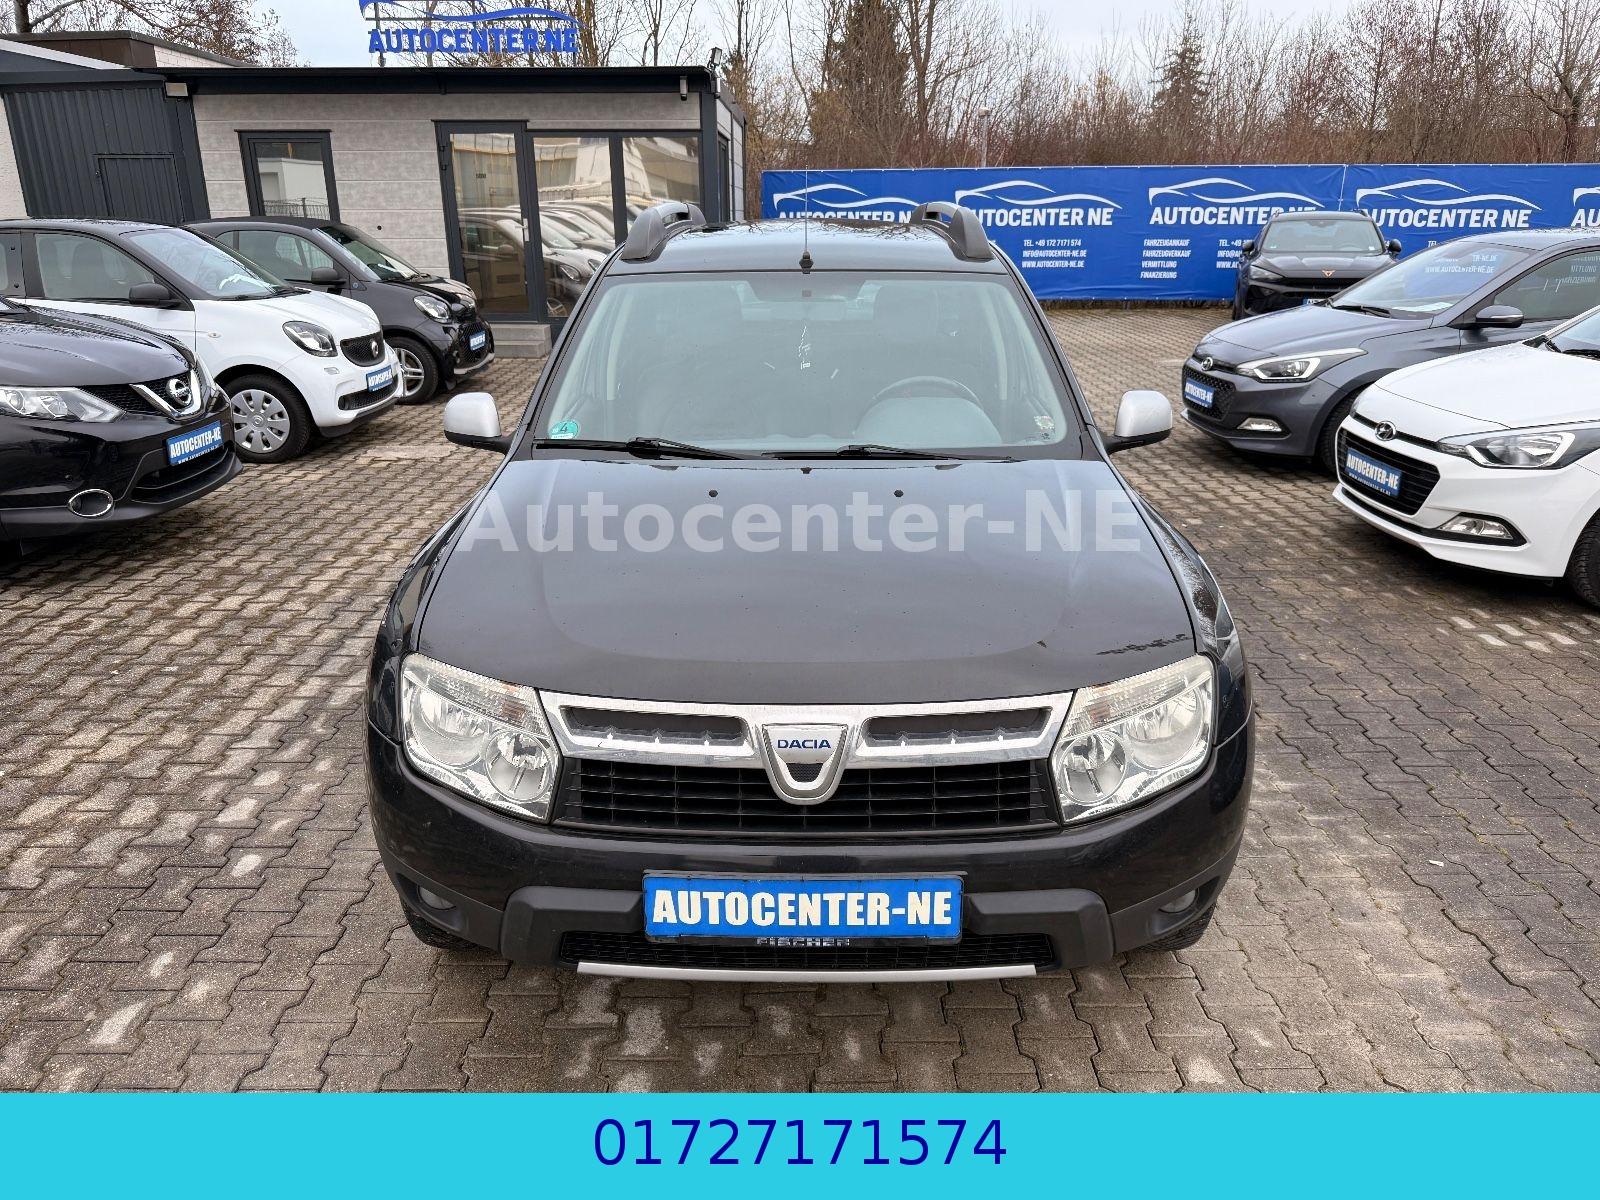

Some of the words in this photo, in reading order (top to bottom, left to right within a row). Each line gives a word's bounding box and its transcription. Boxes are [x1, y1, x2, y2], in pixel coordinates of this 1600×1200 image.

[369, 28, 540, 53] AUTOCENTER
[542, 28, 578, 53] NE
[1087, 207, 1114, 226] NE
[1363, 208, 1497, 228] UTOCENTER
[1501, 208, 1532, 228] NE
[1035, 239, 1045, 247] +49
[1046, 239, 1056, 247] 172
[1070, 239, 1082, 247] 574
[169, 426, 222, 459] AUTOCENTER-NE
[1346, 453, 1399, 490] AUTOCENTER-NE
[777, 739, 832, 749] DACIA
[652, 889, 952, 927] AUTOCENTER-NE
